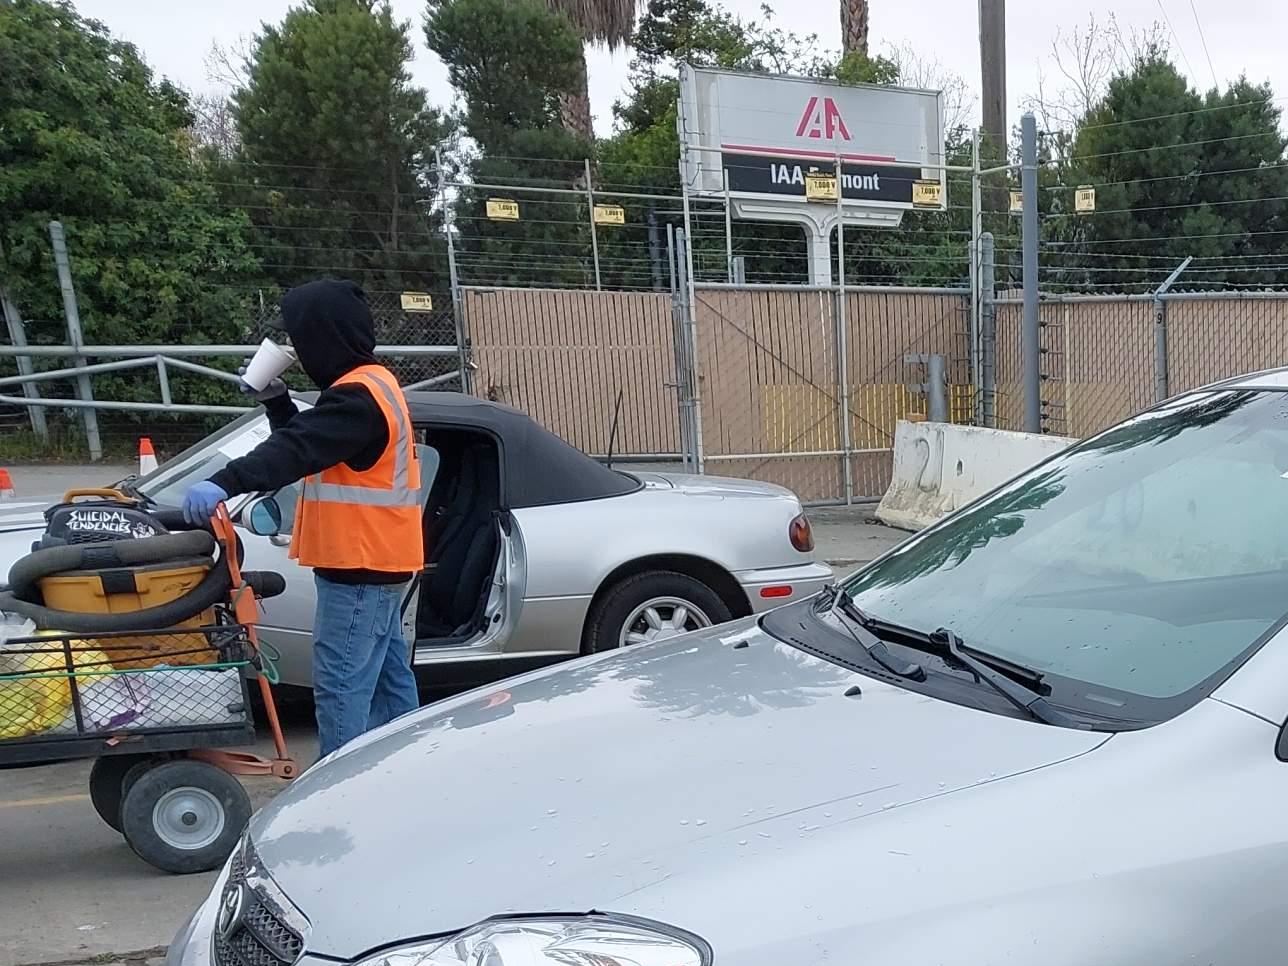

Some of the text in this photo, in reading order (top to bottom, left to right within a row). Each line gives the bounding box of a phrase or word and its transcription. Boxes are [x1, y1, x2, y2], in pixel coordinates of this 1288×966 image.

[771, 164, 805, 184] IAA
[69, 510, 131, 522] SUICIDAL
[66, 521, 131, 533] TENDENCIES
